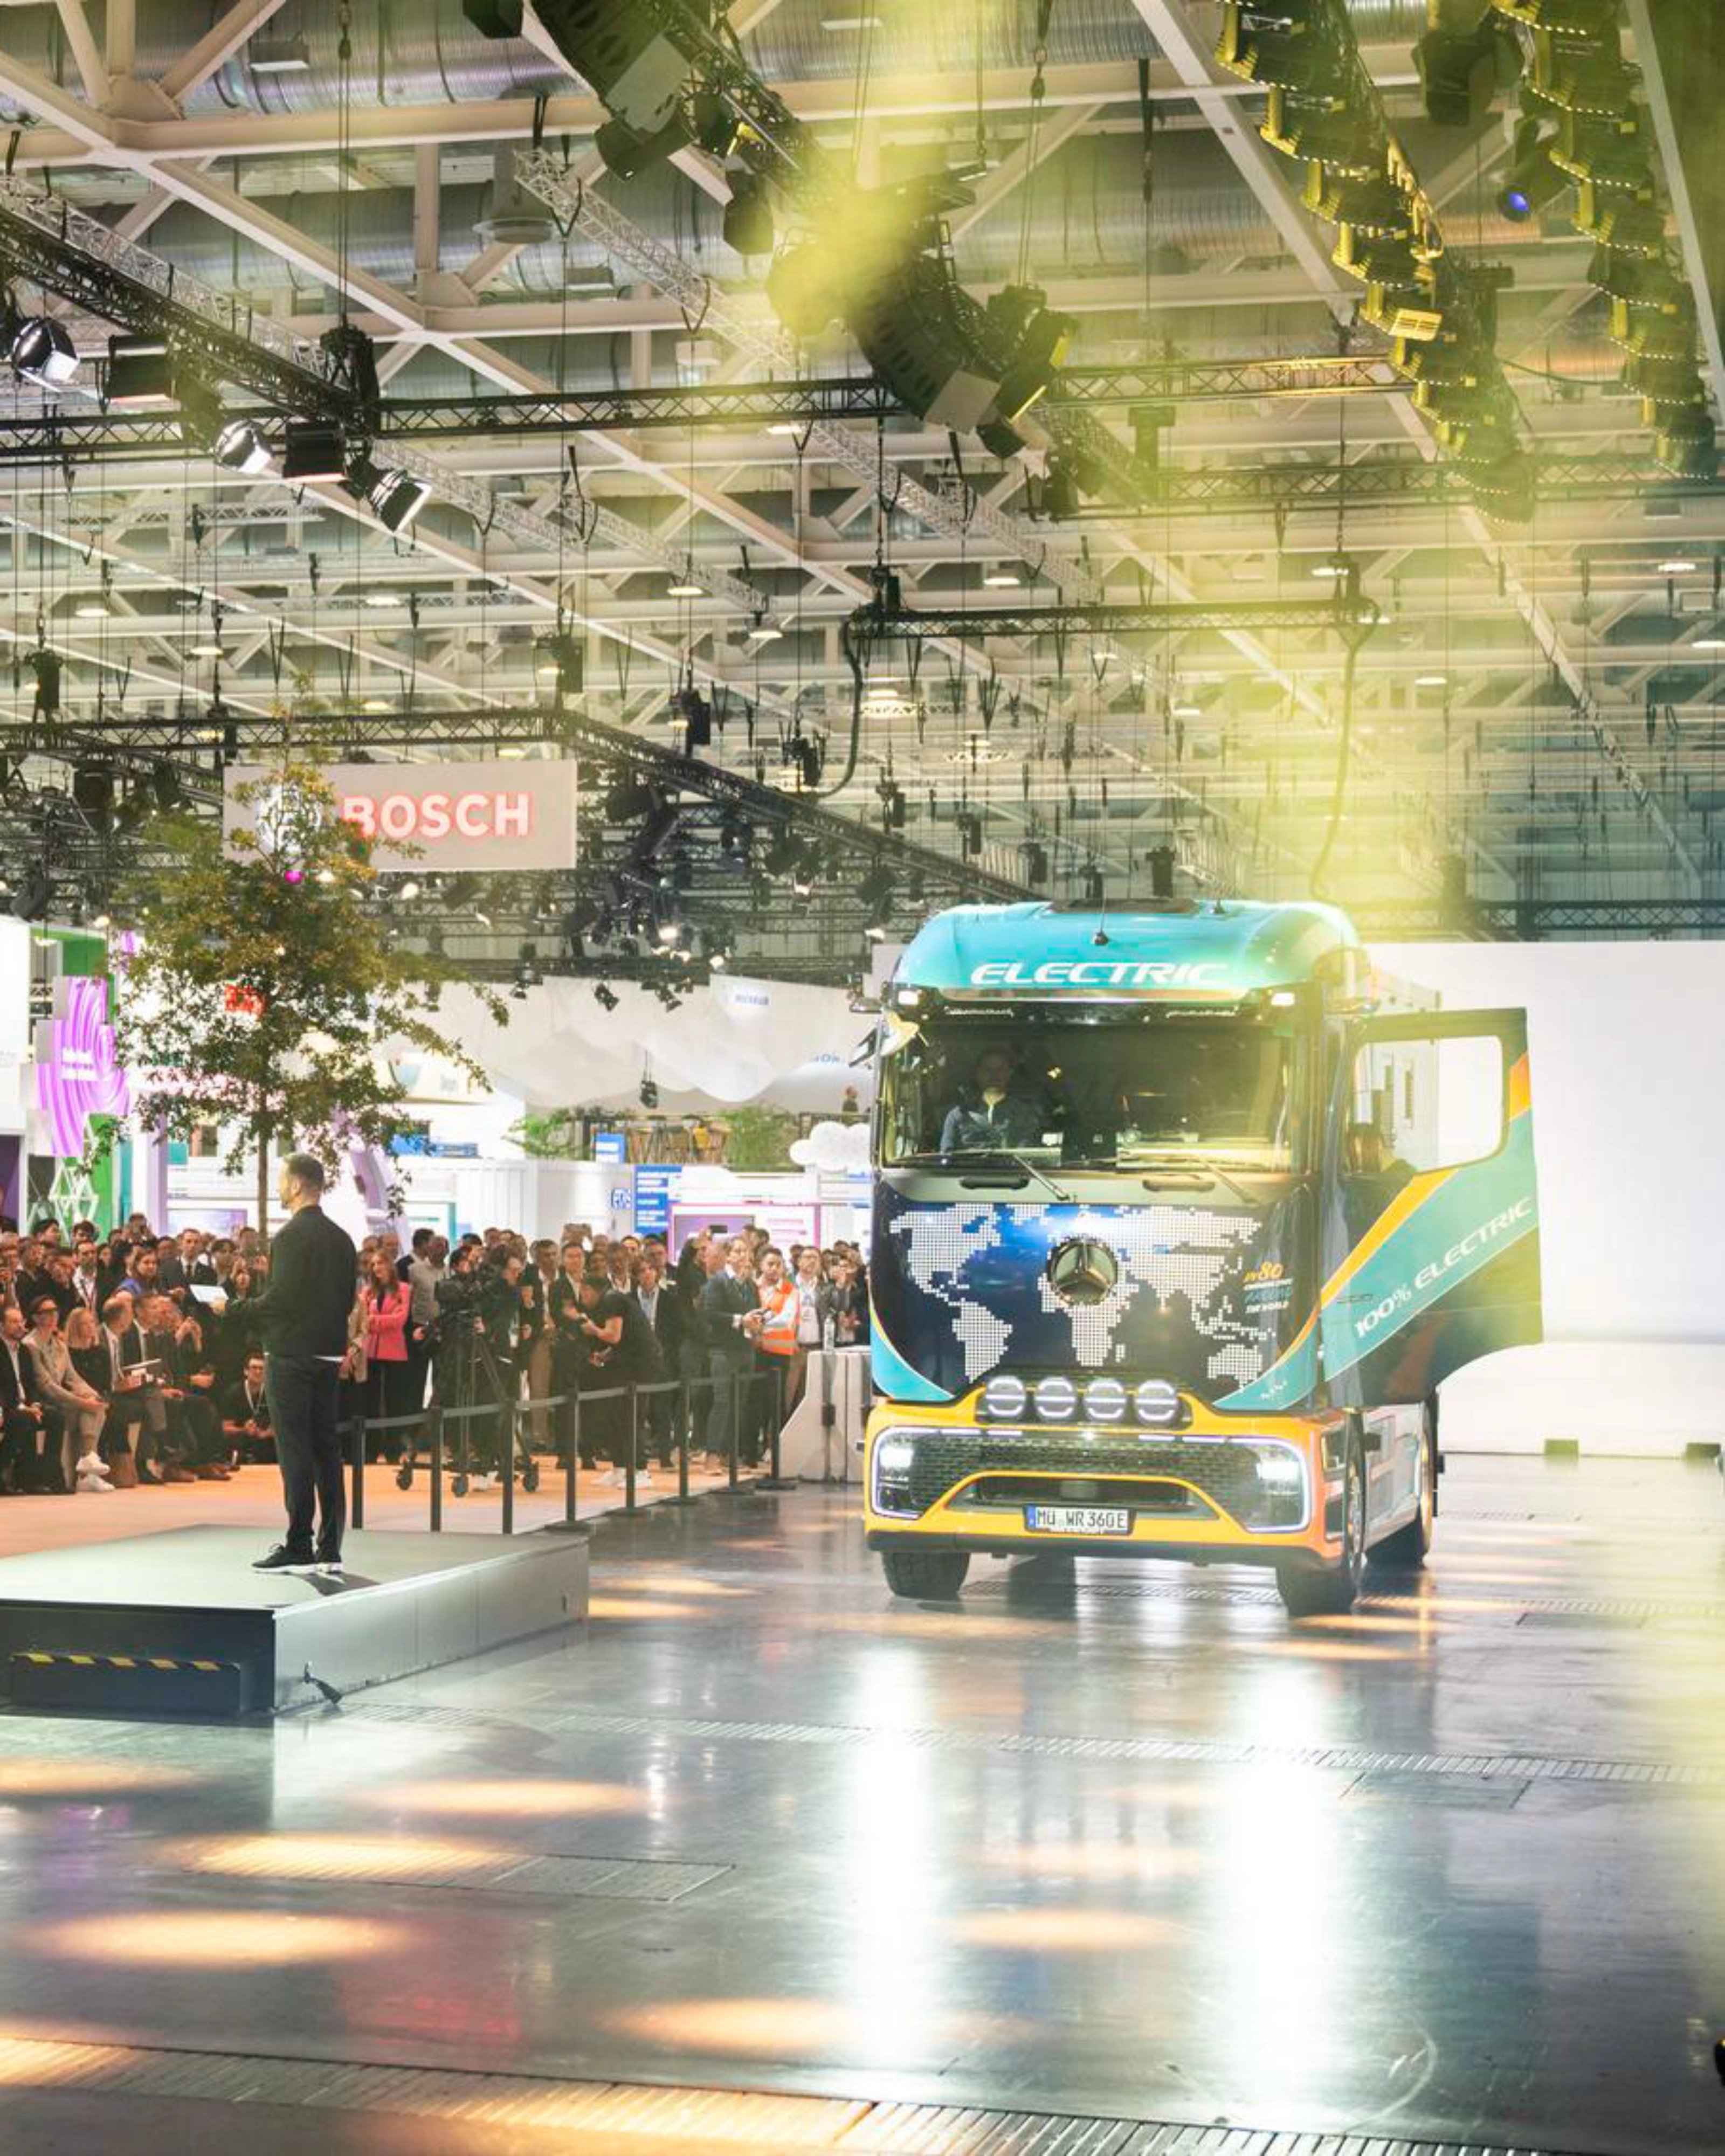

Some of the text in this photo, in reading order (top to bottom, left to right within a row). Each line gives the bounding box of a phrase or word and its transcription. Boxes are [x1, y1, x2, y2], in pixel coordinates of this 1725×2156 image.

[343, 794, 529, 838] BOSCH
[970, 962, 1229, 985] ELECTRIC
[1259, 1261, 1284, 1280] 80
[1355, 1197, 1531, 1338] 100% ELECTRIC
